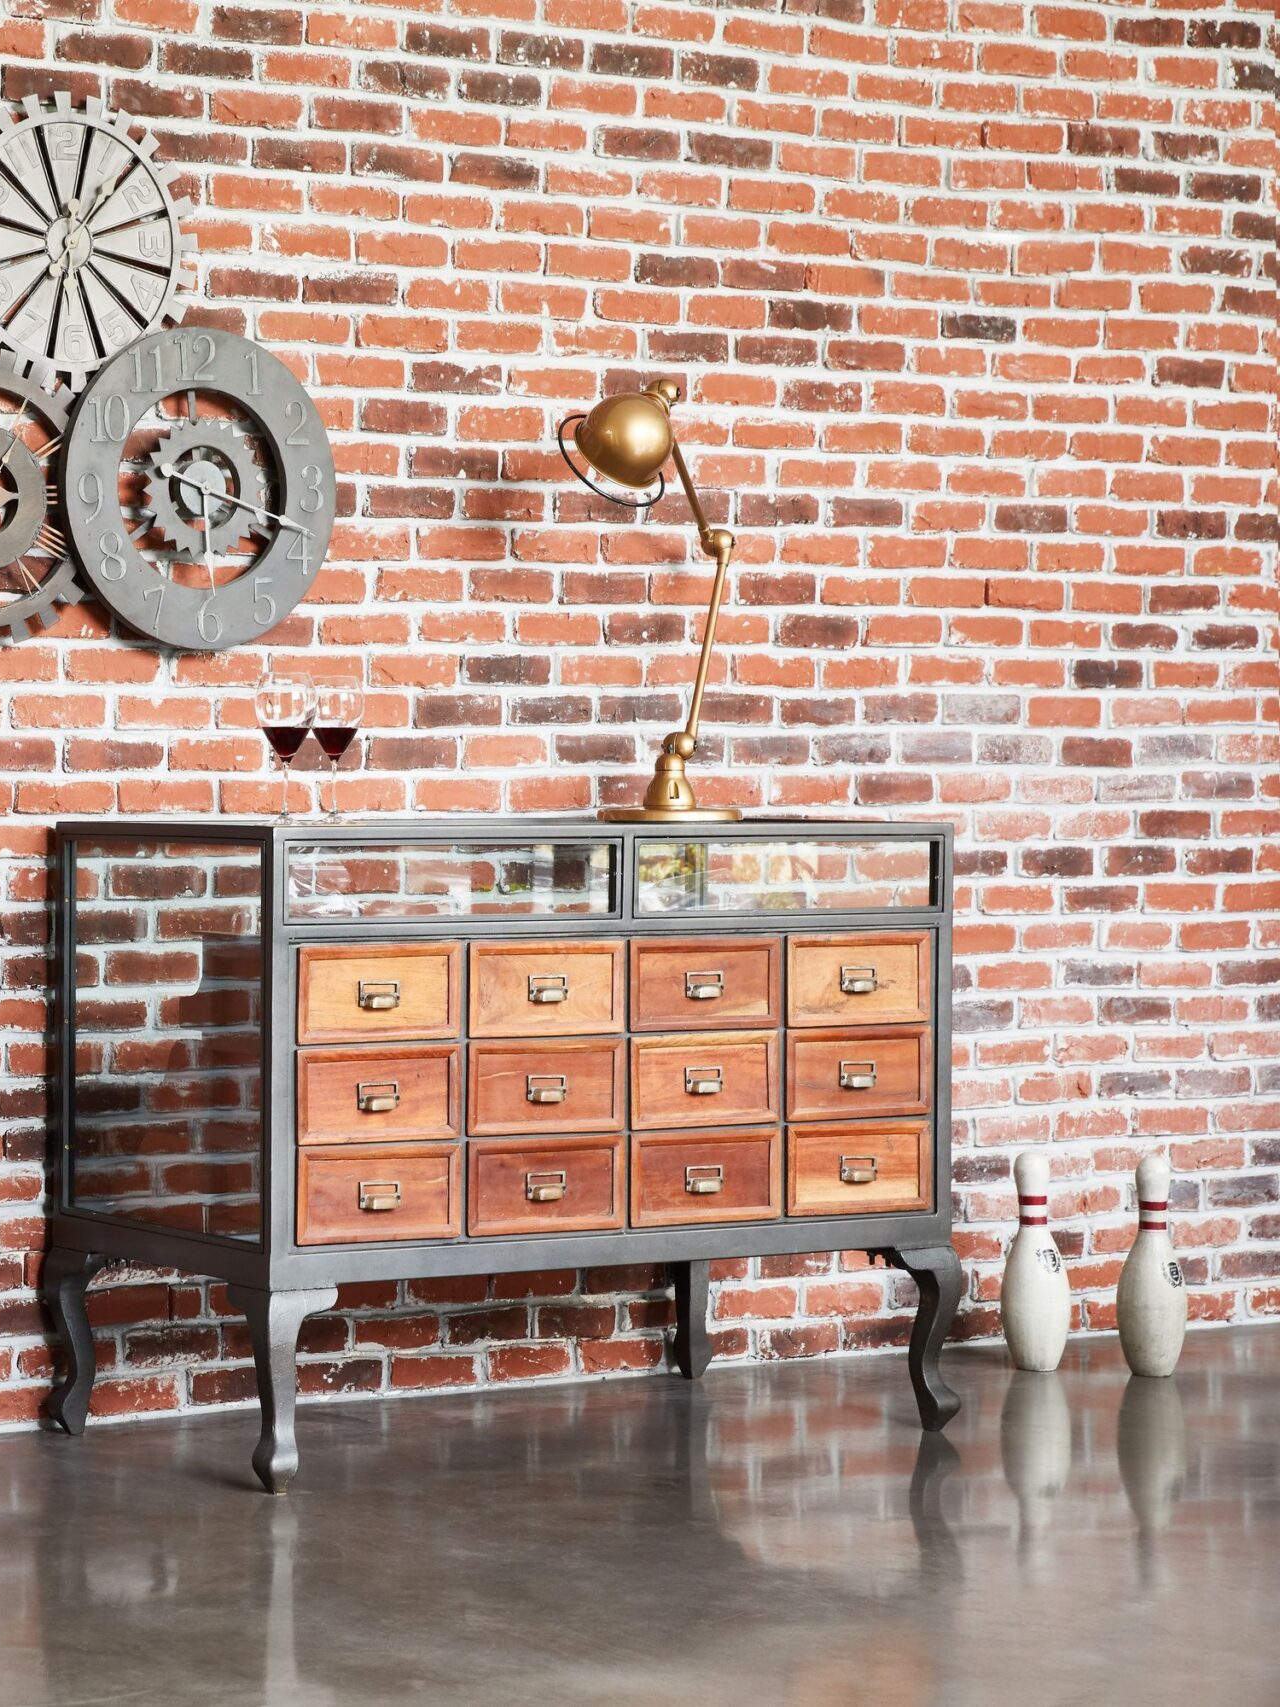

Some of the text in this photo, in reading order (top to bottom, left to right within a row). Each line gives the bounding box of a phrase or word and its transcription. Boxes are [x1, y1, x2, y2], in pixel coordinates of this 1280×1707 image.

[122, 177, 155, 215] 2
[137, 230, 171, 258] 3
[130, 273, 162, 313] 4
[15, 307, 48, 343] 7
[63, 324, 88, 361] 6
[99, 306, 132, 347] 5
[127, 348, 170, 393] 11
[173, 333, 217, 382] 12
[243, 349, 264, 396] 1
[88, 394, 131, 443] 10
[284, 400, 310, 447] 2
[77, 471, 105, 525] 9
[299, 464, 324, 514] 3
[99, 530, 128, 582] 8
[285, 529, 313, 576] 4
[143, 584, 166, 630] 7
[196, 596, 224, 643] 6
[252, 577, 277, 626] 5
